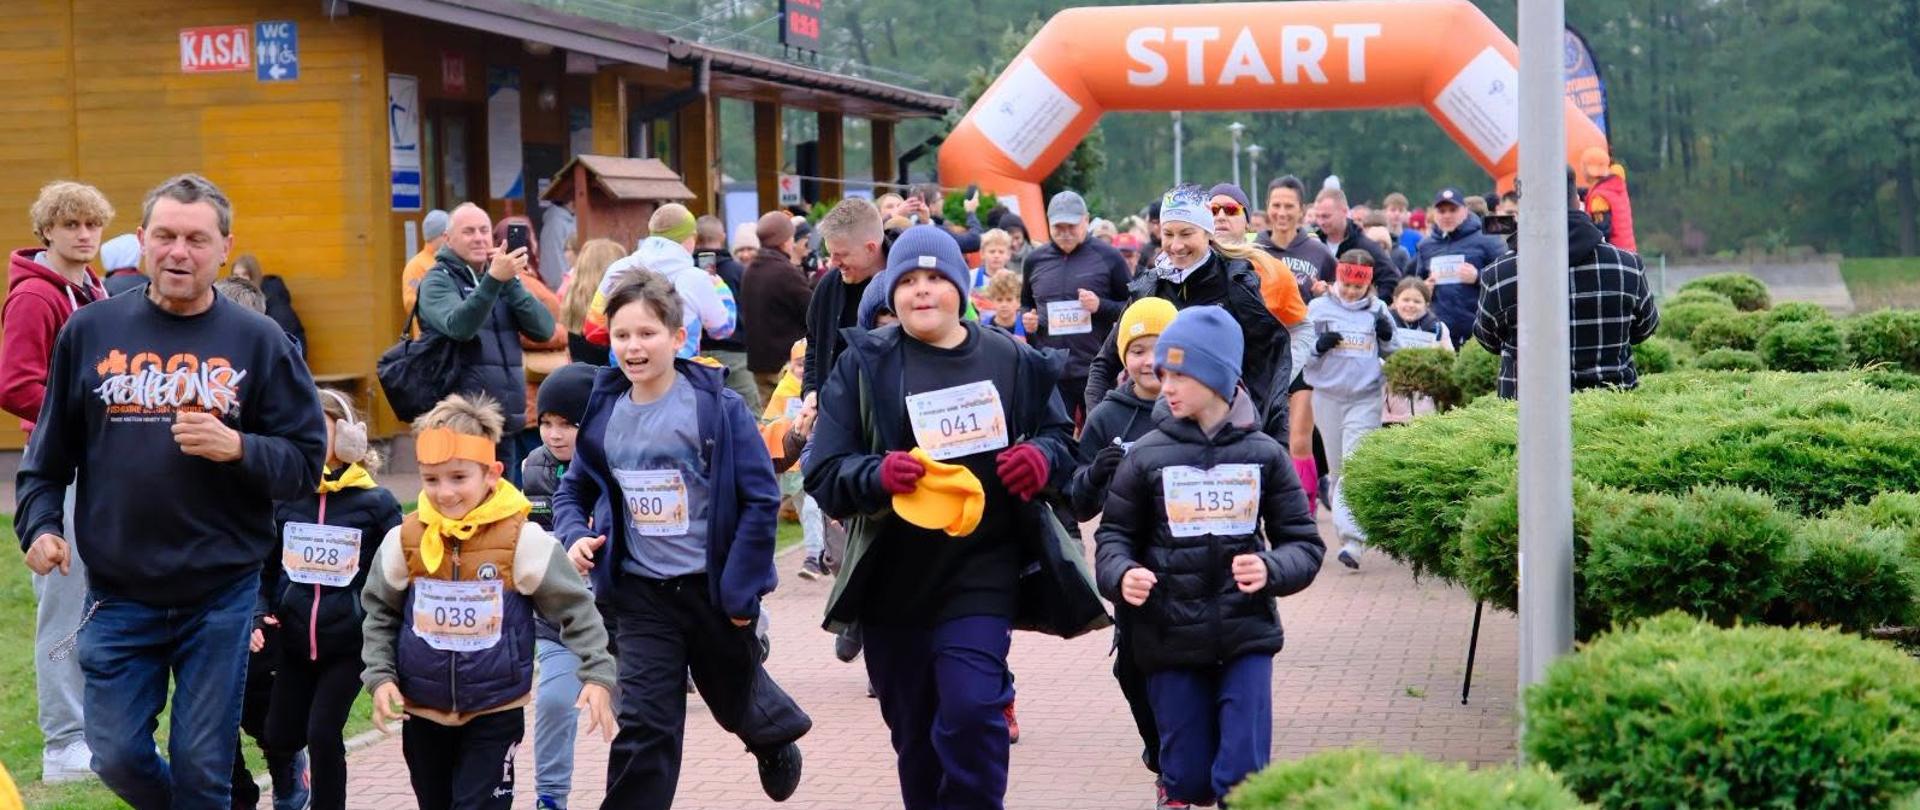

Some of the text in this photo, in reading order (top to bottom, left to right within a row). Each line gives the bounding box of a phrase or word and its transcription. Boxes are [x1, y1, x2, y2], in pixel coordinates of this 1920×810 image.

[262, 23, 289, 38] WC
[182, 33, 249, 66] KASA
[1125, 23, 1382, 86] START
[941, 413, 982, 437] 041
[630, 496, 663, 516] 080
[1194, 491, 1235, 512] 135
[303, 546, 339, 566] 028
[435, 606, 476, 628] 038
